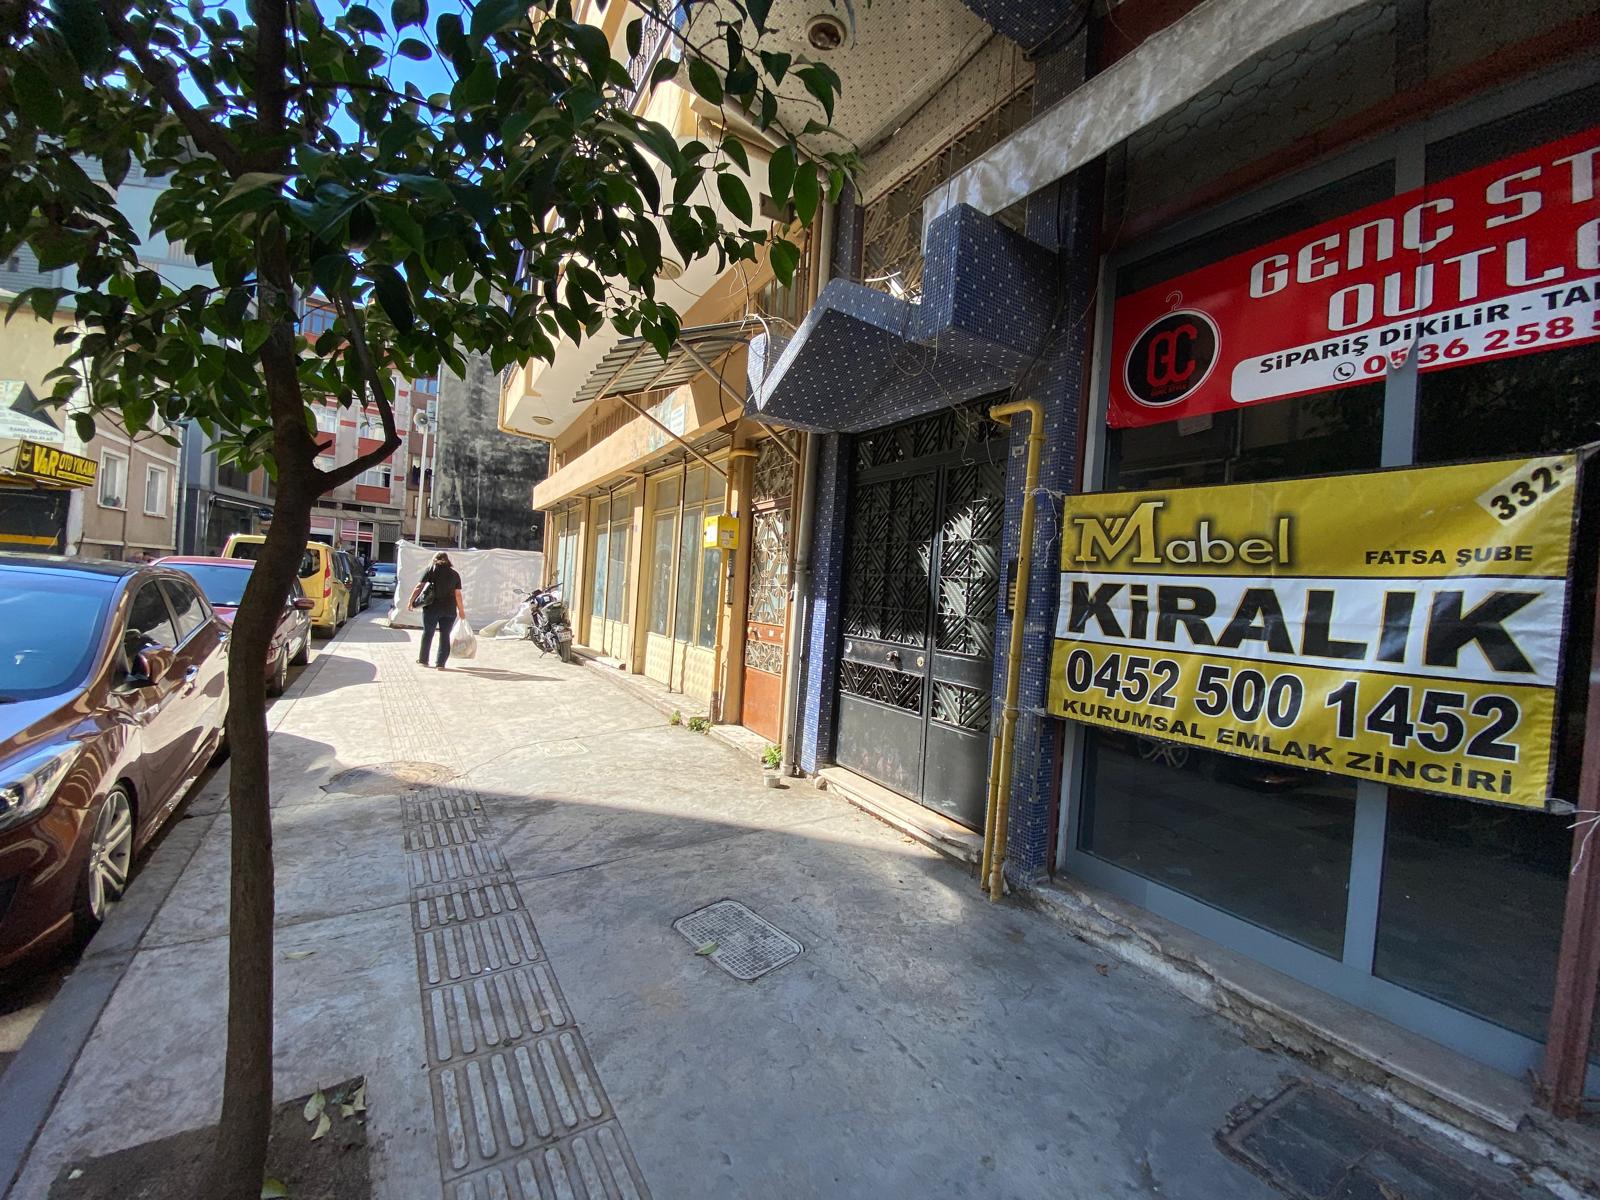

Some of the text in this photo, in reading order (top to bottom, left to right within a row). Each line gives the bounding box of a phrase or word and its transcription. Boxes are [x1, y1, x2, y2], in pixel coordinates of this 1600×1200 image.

[1249, 198, 1455, 299] GENÇ
[1541, 282, 1600, 310] TA
[1484, 316, 1575, 352] 258
[1074, 501, 1289, 564] Mabel
[1365, 545, 1533, 568] FATSA ŞUBE
[1062, 699, 1206, 740] KURUMSAL
[1216, 727, 1334, 765] EMLAK
[1066, 649, 1521, 763] 0452 500 1452
